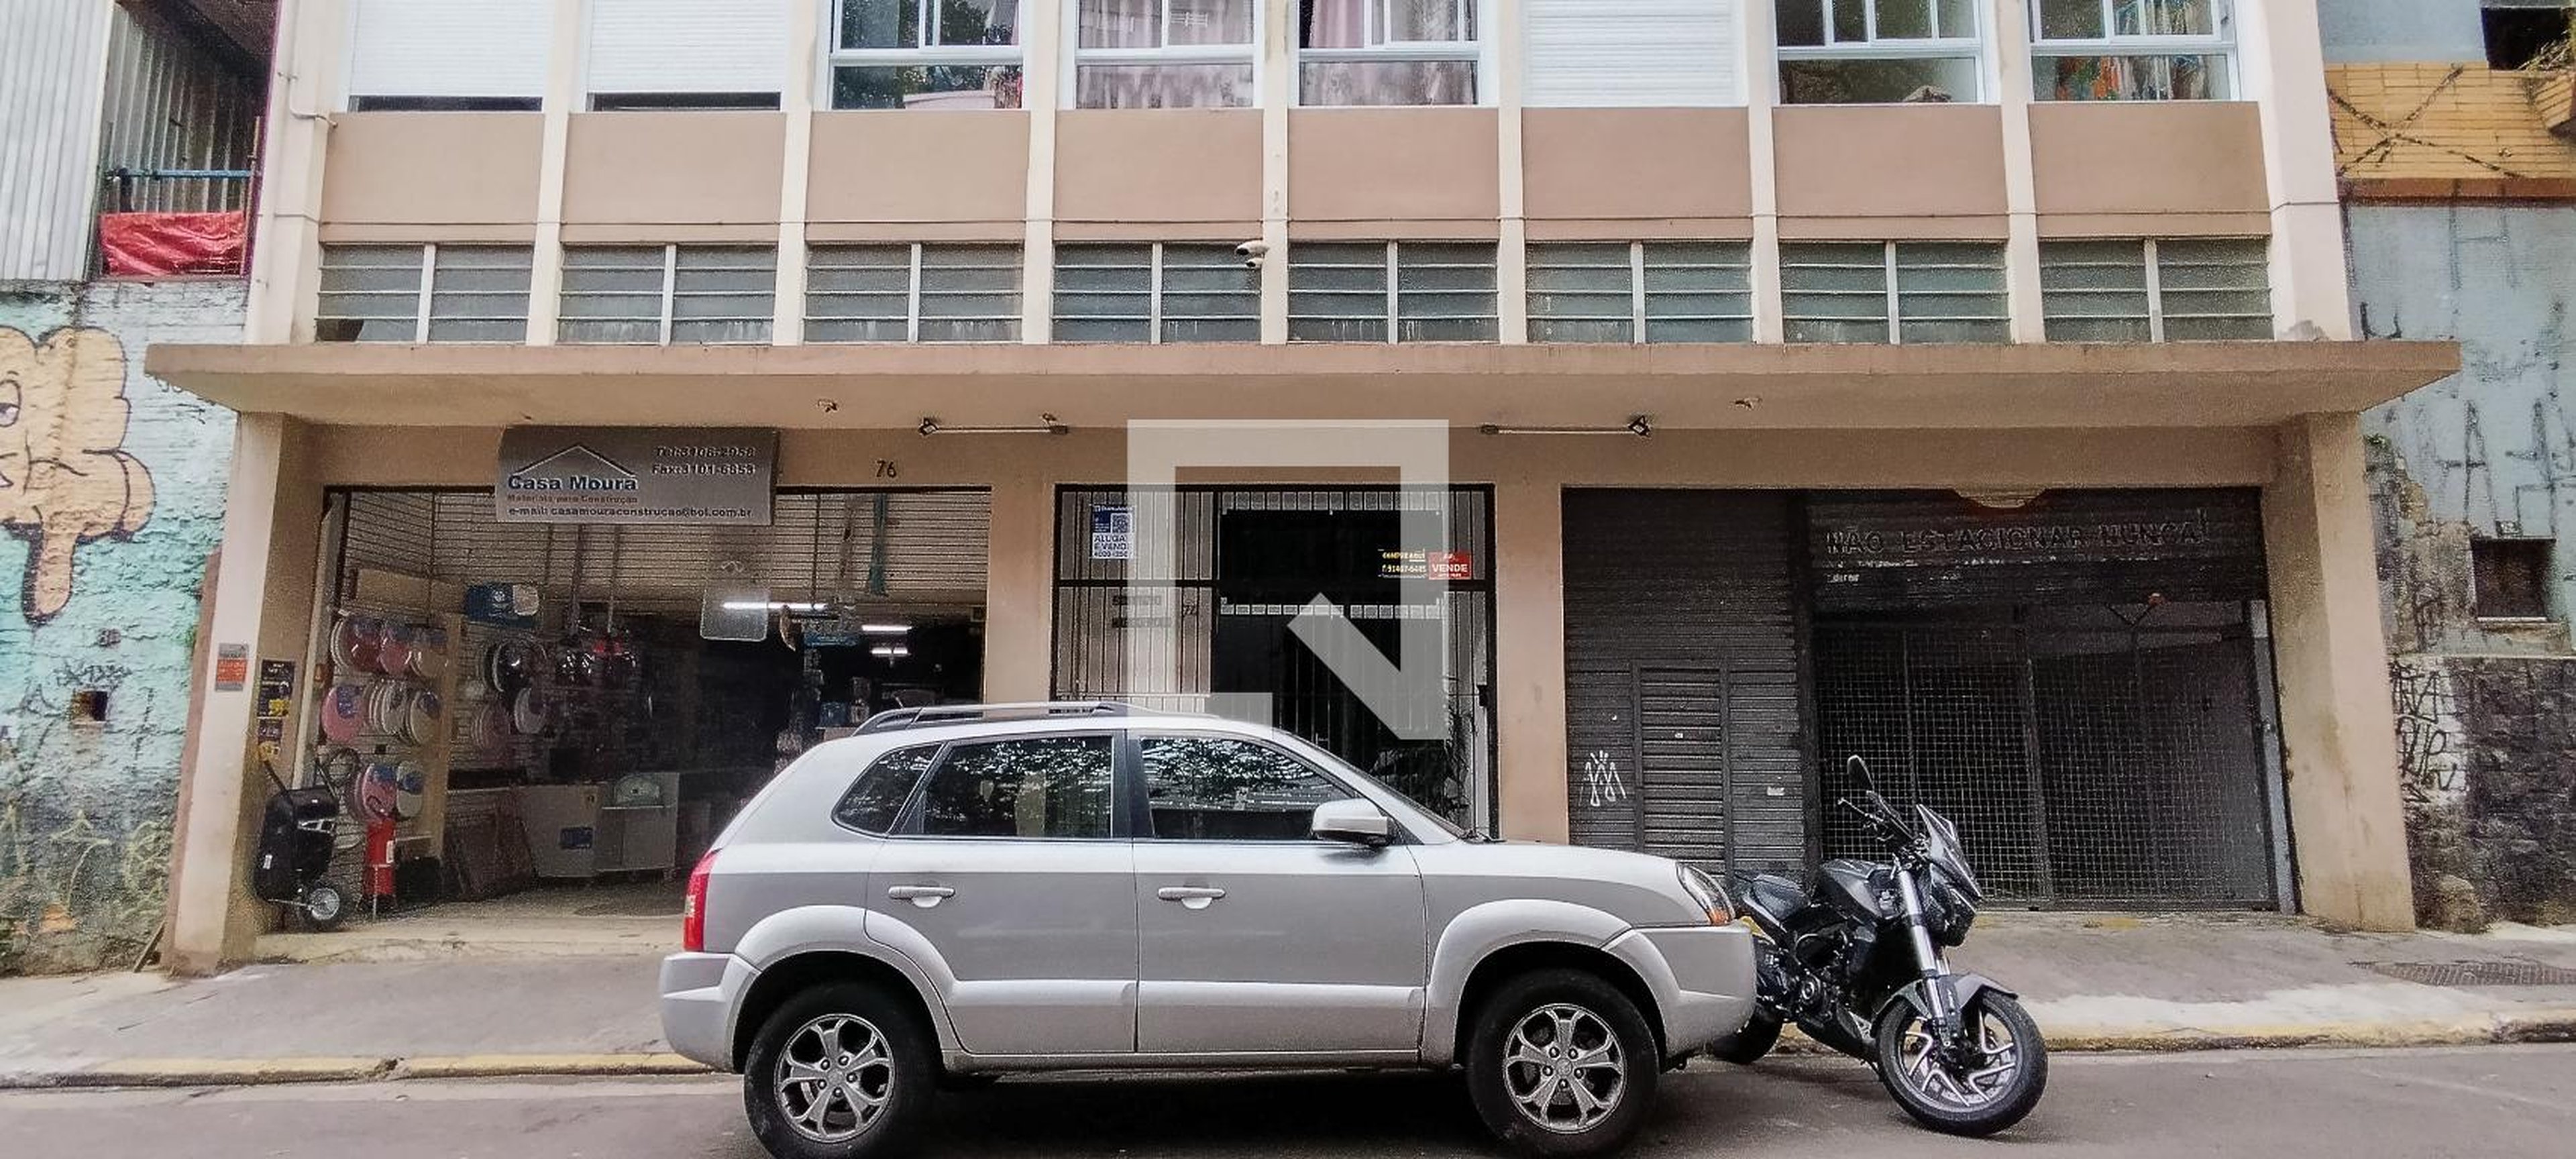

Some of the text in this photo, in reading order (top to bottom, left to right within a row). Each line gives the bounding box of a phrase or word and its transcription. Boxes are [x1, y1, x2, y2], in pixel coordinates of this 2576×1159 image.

[876, 460, 897, 478] 76
[508, 475, 638, 490] Casa Moura
[508, 506, 548, 515] e-mail:
[1432, 563, 1468, 572] VENDE
